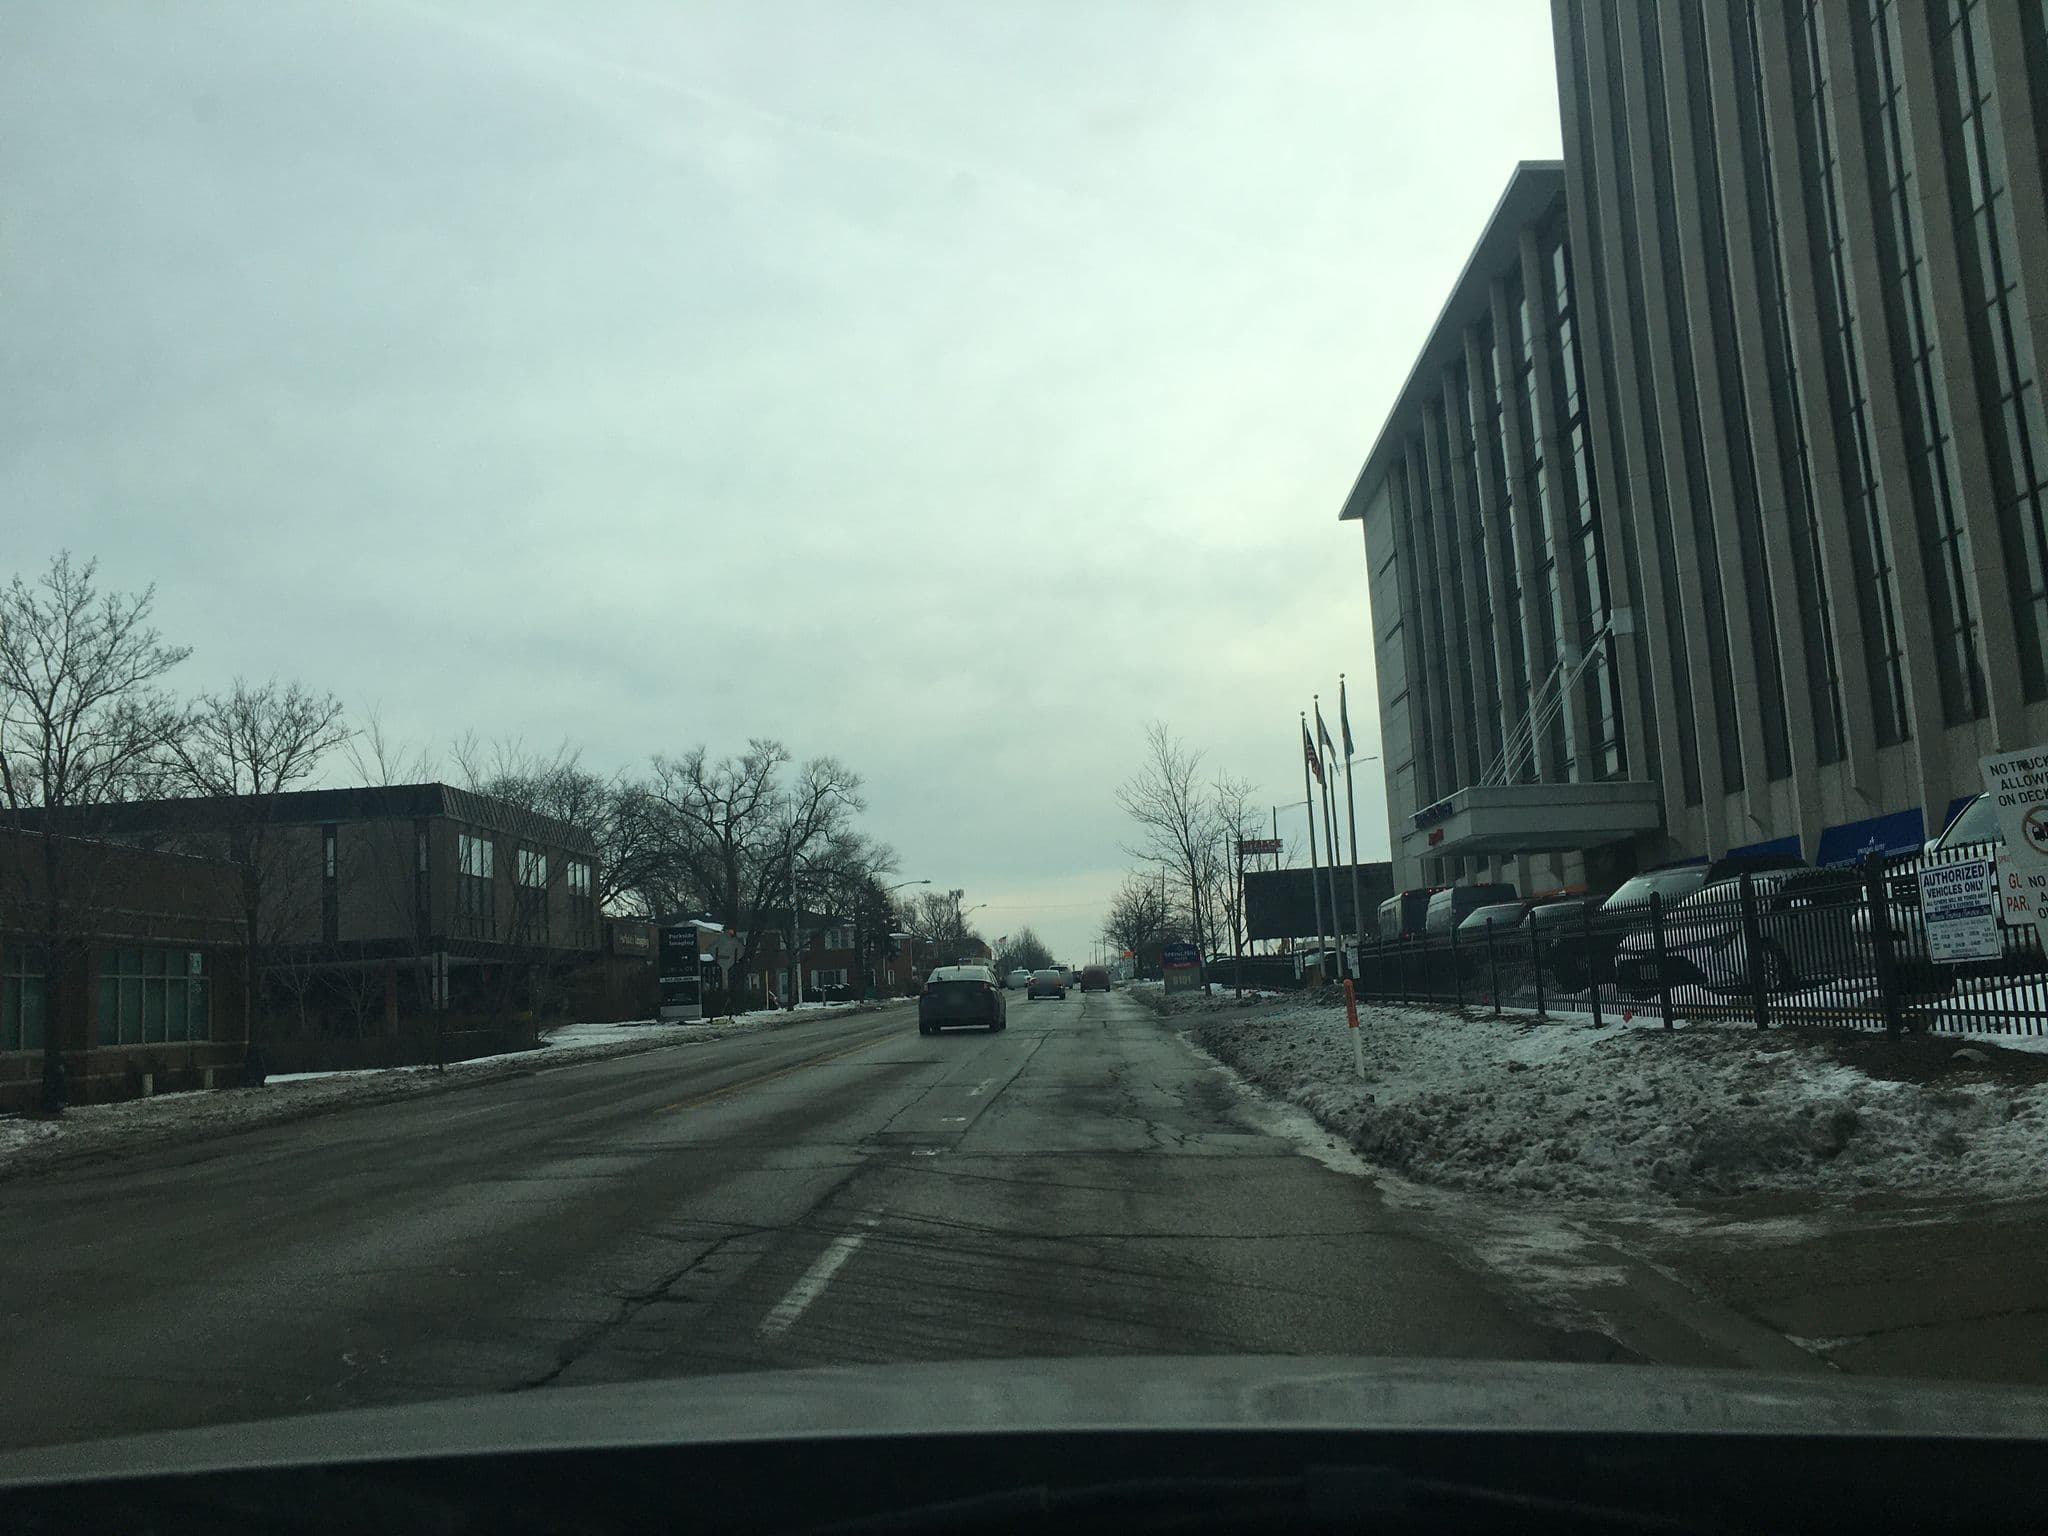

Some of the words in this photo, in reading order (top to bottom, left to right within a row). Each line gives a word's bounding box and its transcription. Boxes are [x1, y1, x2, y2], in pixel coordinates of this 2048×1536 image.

[1989, 763, 2008, 776] NO
[1998, 793, 2017, 806] ON
[1923, 864, 1985, 887] AUTHORIZED
[2028, 875, 2046, 888] NO
[1926, 884, 1962, 898] VEHICLES
[1964, 880, 1984, 893] ONLY
[2006, 895, 2030, 912] PAR
